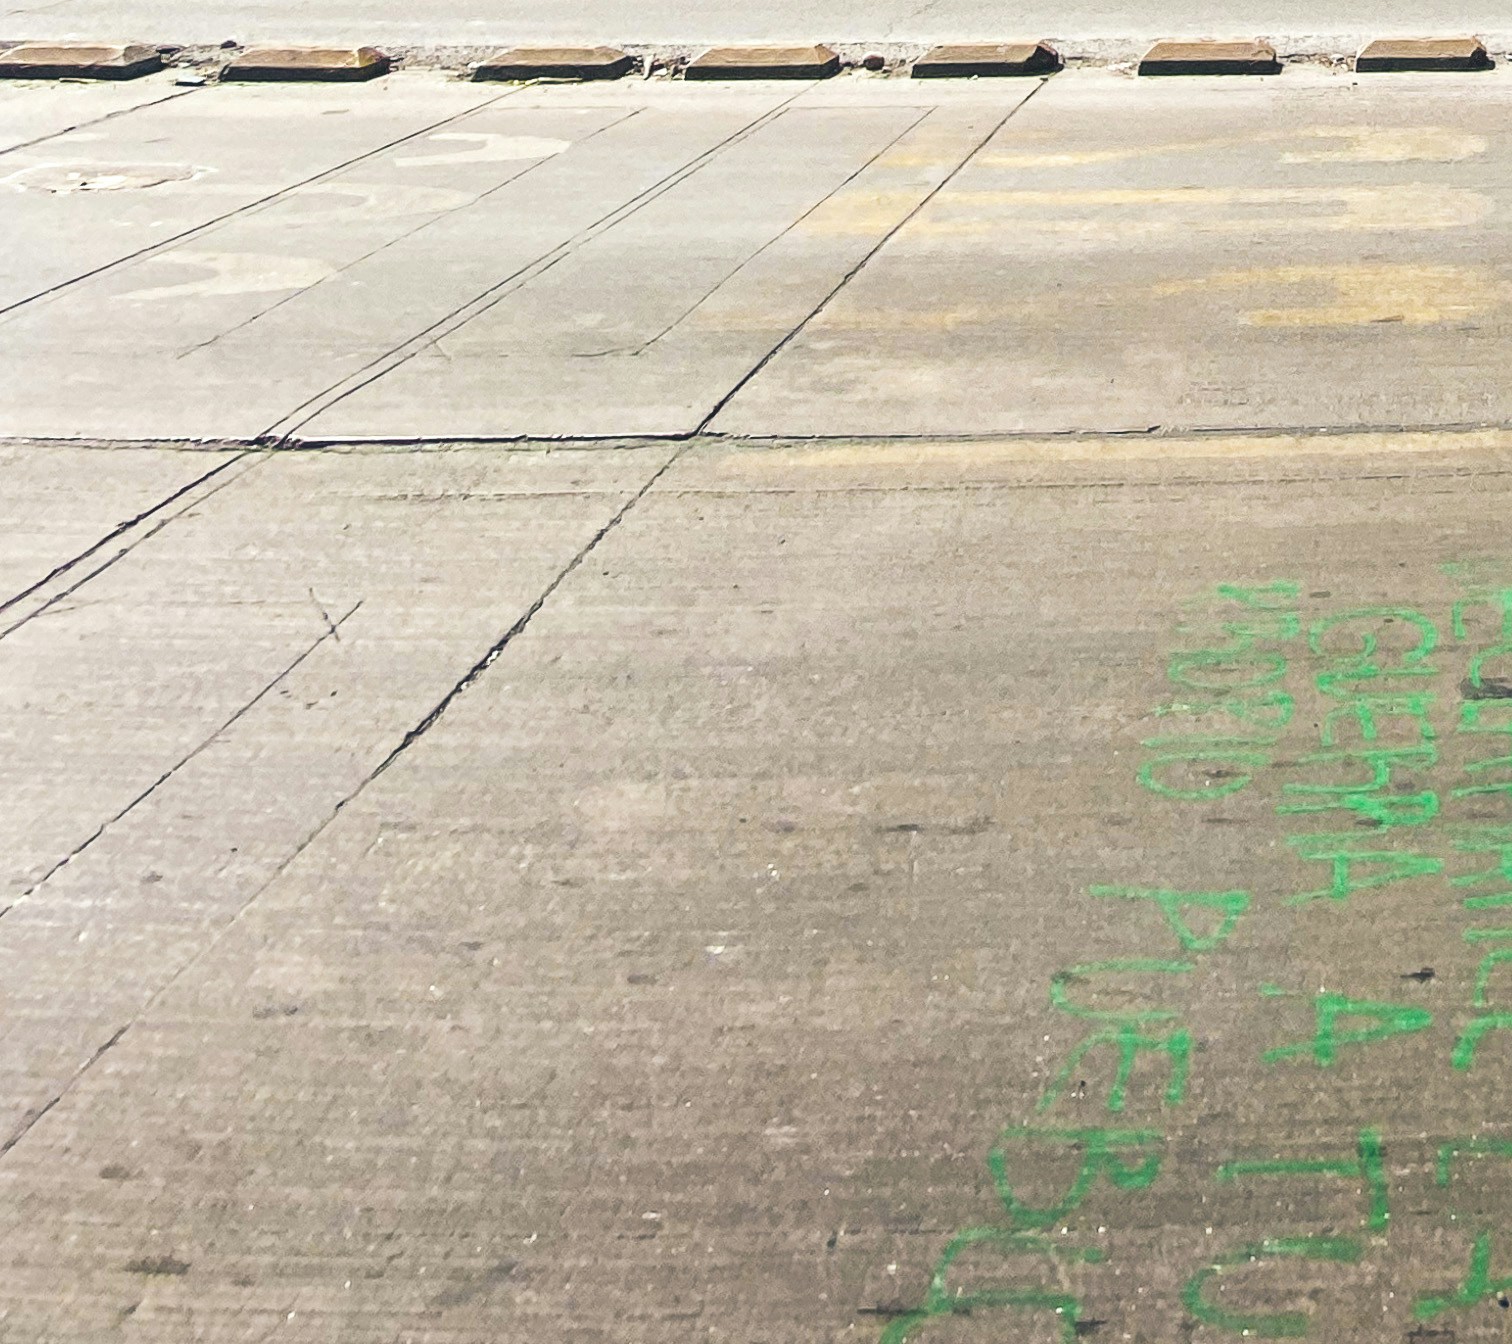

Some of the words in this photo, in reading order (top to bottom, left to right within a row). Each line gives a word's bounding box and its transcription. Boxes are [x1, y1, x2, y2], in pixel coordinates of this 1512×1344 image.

[1137, 577, 1302, 800] PROPIO
[1275, 605, 1446, 906] GUERRA
[1260, 982, 1434, 1067] A
[1183, 1125, 1391, 1337] TU
